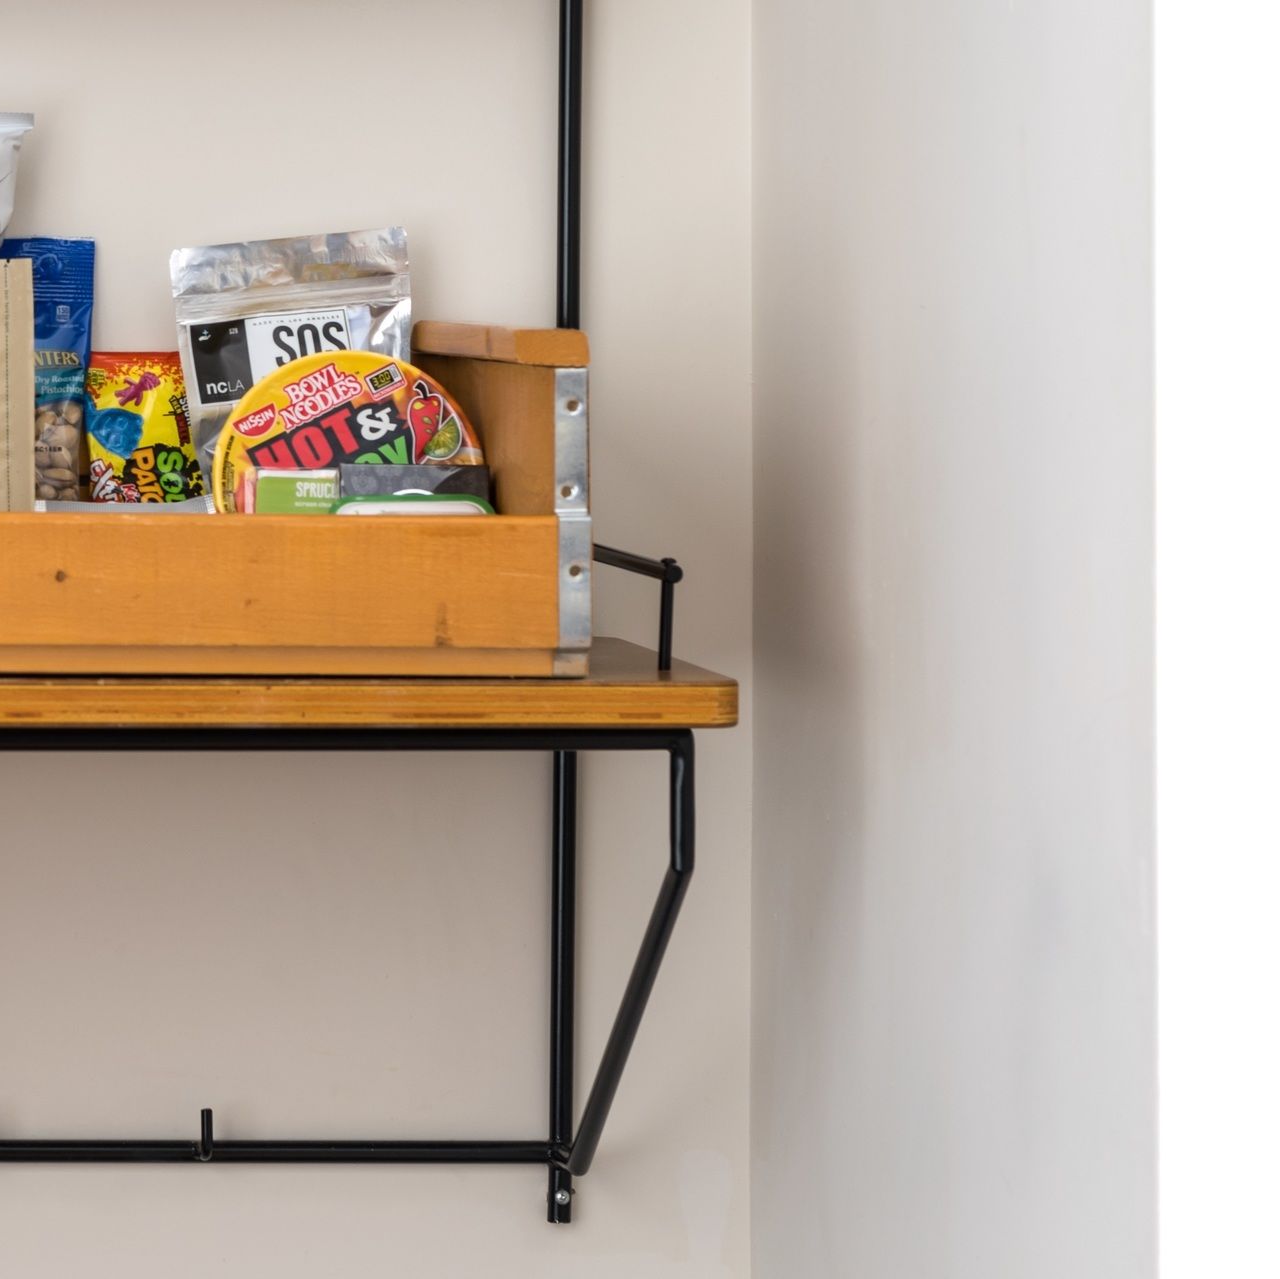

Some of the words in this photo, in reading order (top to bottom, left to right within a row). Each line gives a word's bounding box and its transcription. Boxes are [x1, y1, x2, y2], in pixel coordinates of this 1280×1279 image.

[33, 351, 81, 367] NTERS
[272, 321, 347, 368] SOS
[206, 379, 246, 396] ncLA
[279, 373, 362, 432] NOODLES
[284, 363, 341, 405] BOWL
[238, 407, 275, 433] NISSIN
[254, 407, 360, 470] HOT
[356, 407, 397, 441] &
